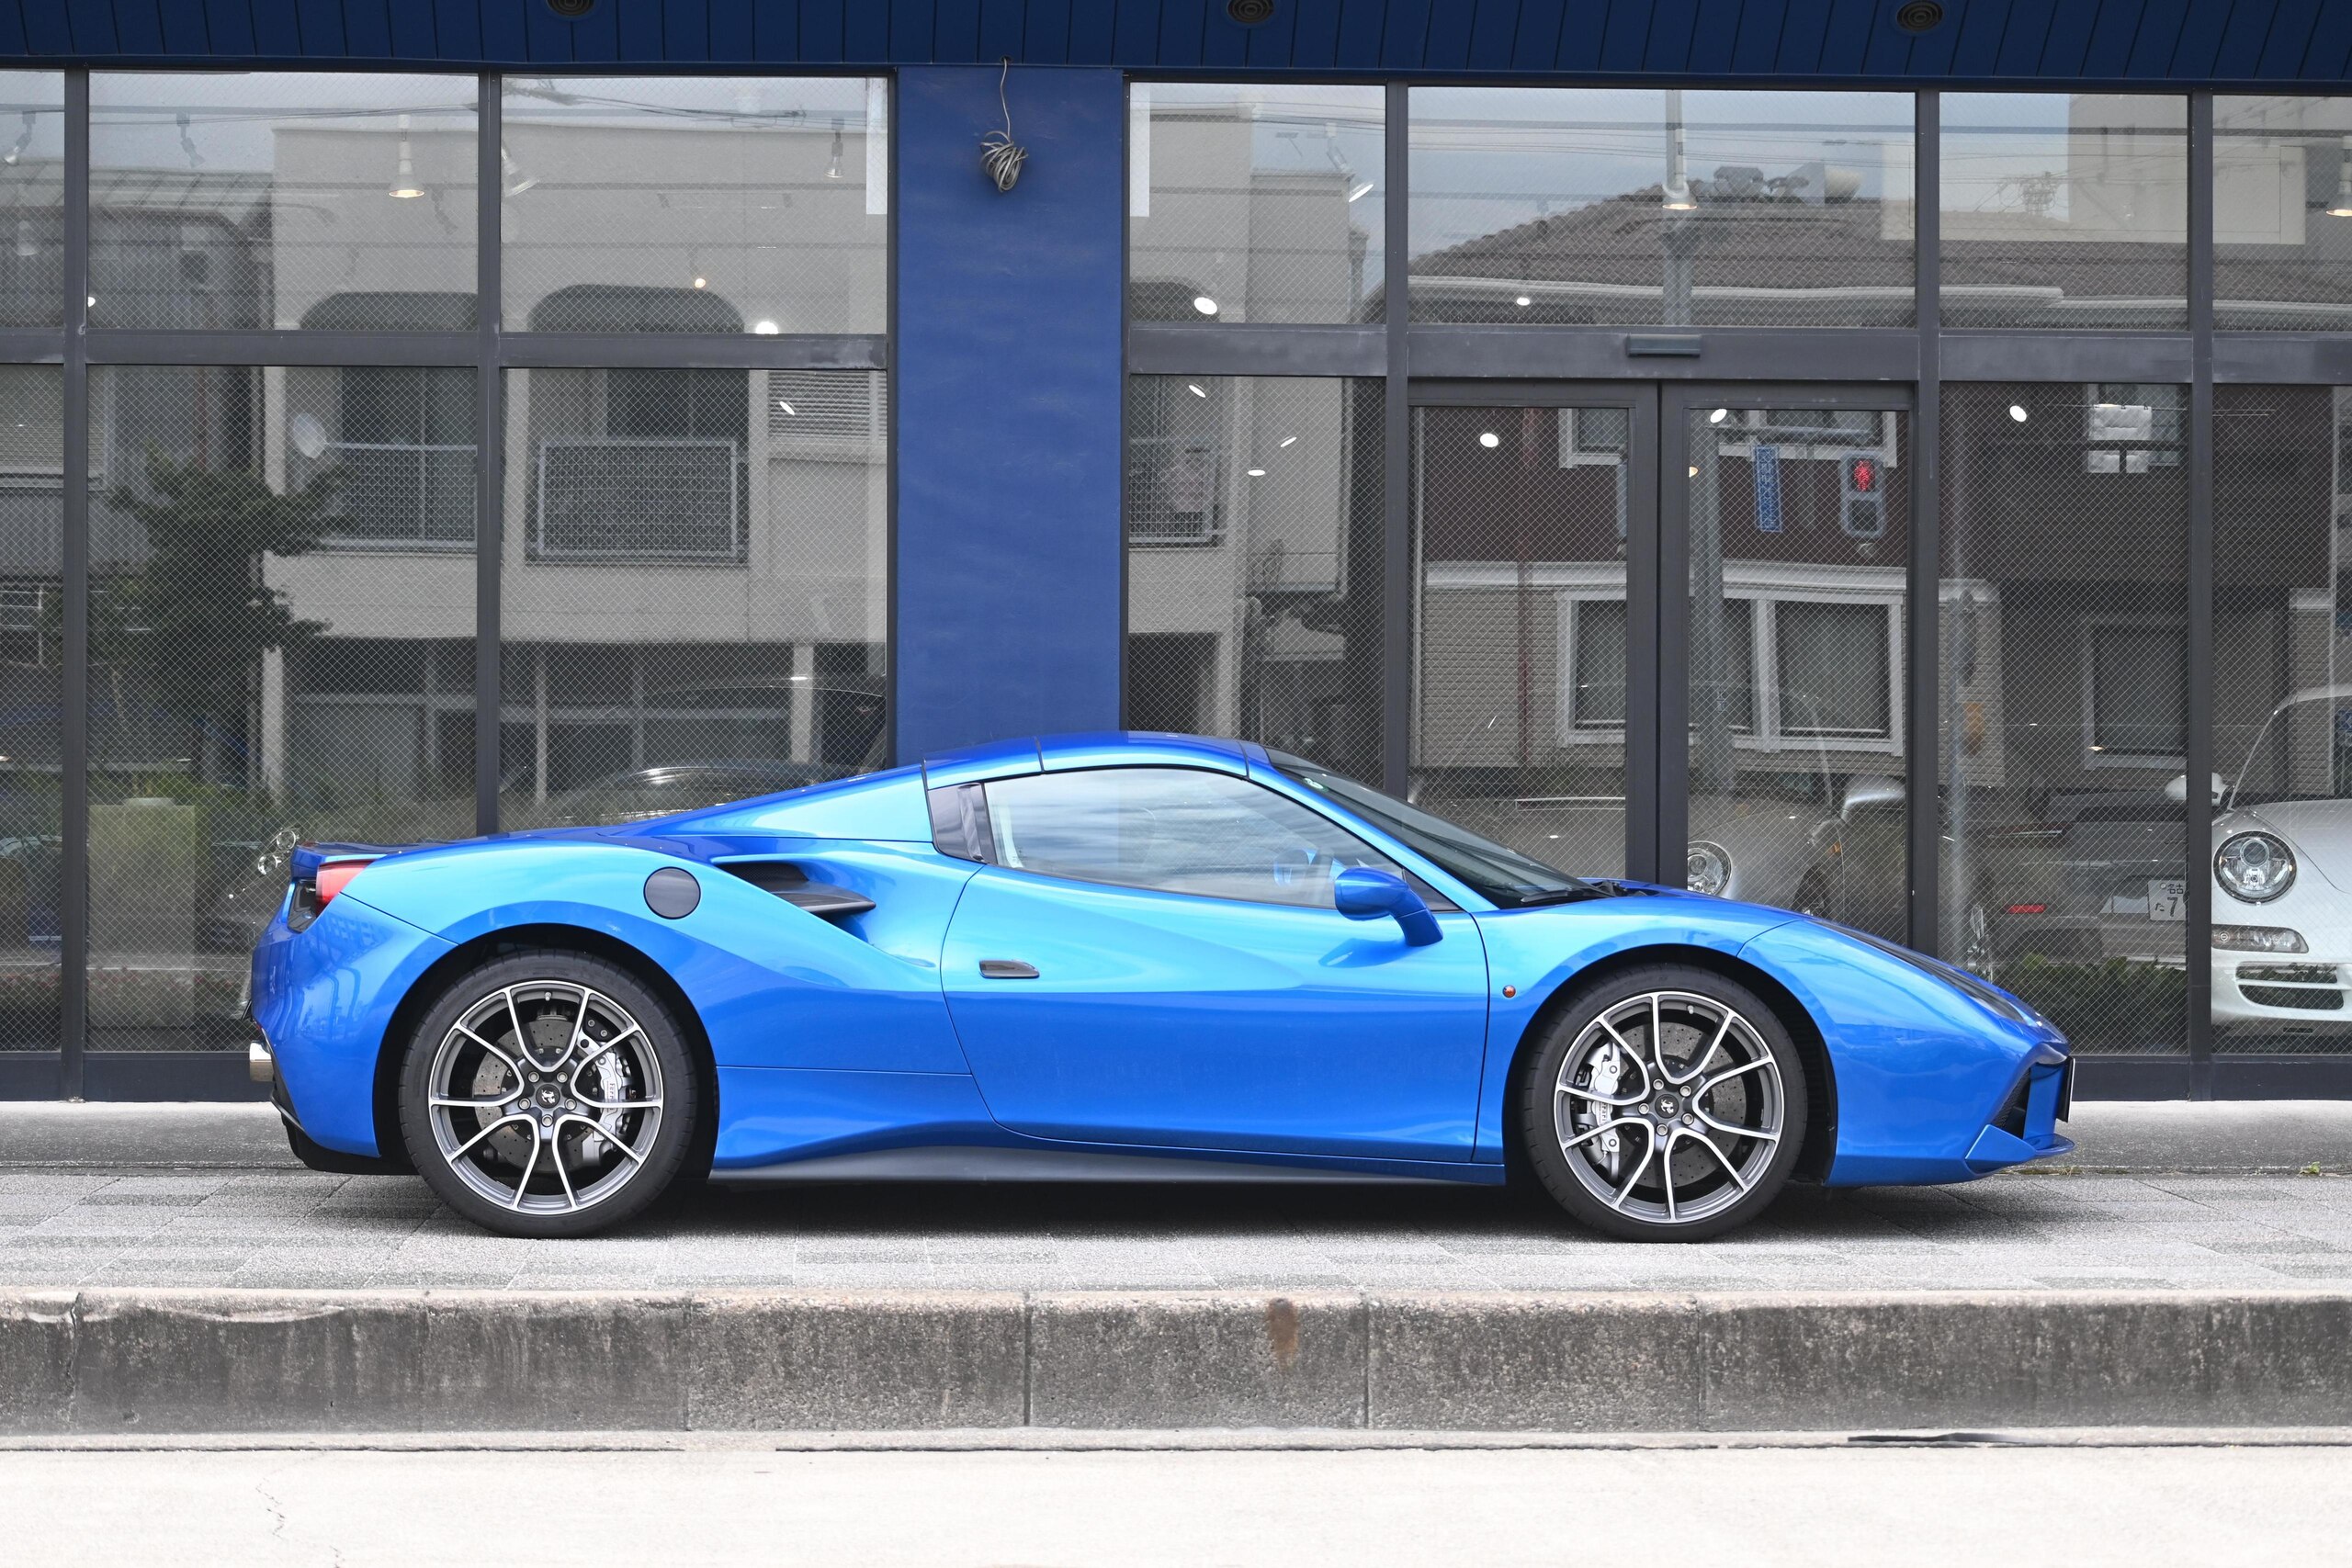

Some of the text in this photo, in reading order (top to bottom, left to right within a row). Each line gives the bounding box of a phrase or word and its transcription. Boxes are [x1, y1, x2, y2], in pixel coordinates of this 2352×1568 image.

[2167, 884, 2184, 895] 名古
[2154, 897, 2178, 918] た 7
